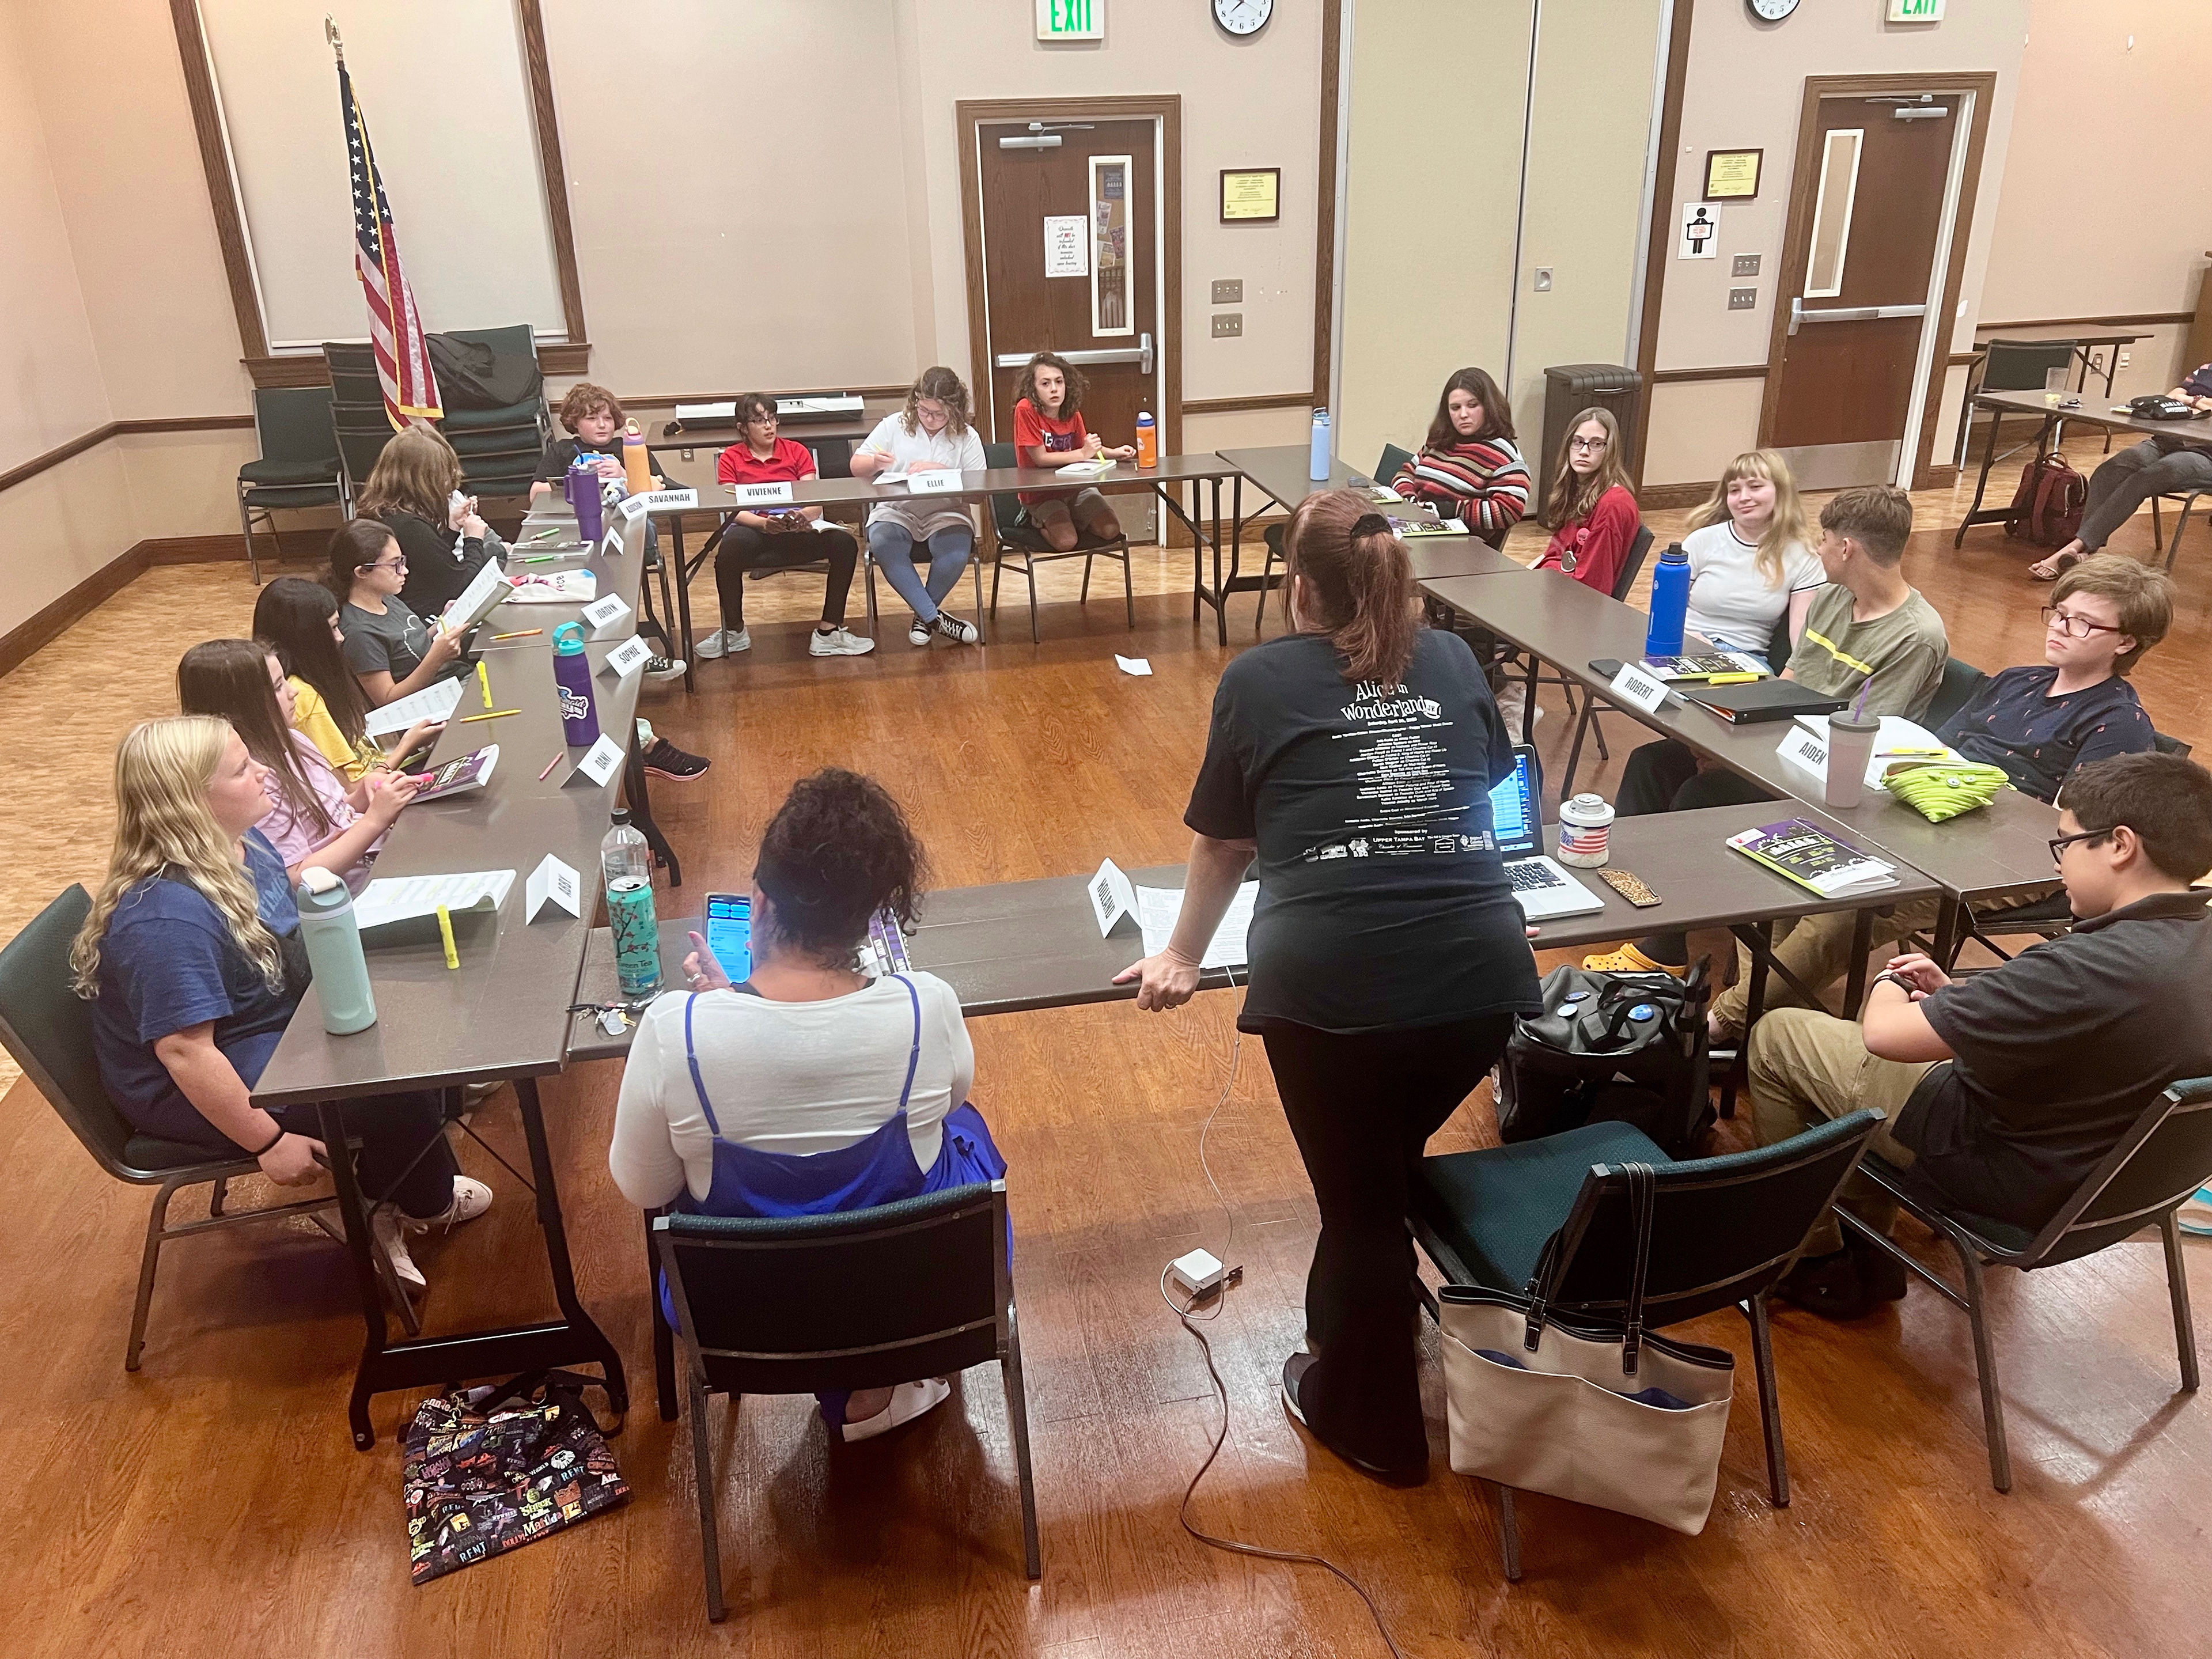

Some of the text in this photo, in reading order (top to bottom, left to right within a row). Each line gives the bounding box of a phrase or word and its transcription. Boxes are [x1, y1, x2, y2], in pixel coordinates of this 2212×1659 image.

[747, 487, 782, 496] VIVIENNE
[927, 479, 945, 487] ELLIE
[649, 494, 690, 503] SAVANNAH
[594, 603, 619, 619] JORDYN
[618, 645, 641, 664] SOPHIE
[1624, 676, 1654, 700] ROBERT
[1340, 695, 1426, 721] Wonderland
[594, 751, 612, 770] DANI
[1798, 741, 1827, 766] AIDEN
[558, 873, 572, 898] ABBY
[1097, 877, 1116, 919] HOLLAND
[560, 1465, 585, 1482] RENT
[522, 1512, 563, 1537] Matilda
[459, 1541, 486, 1563] RENT
